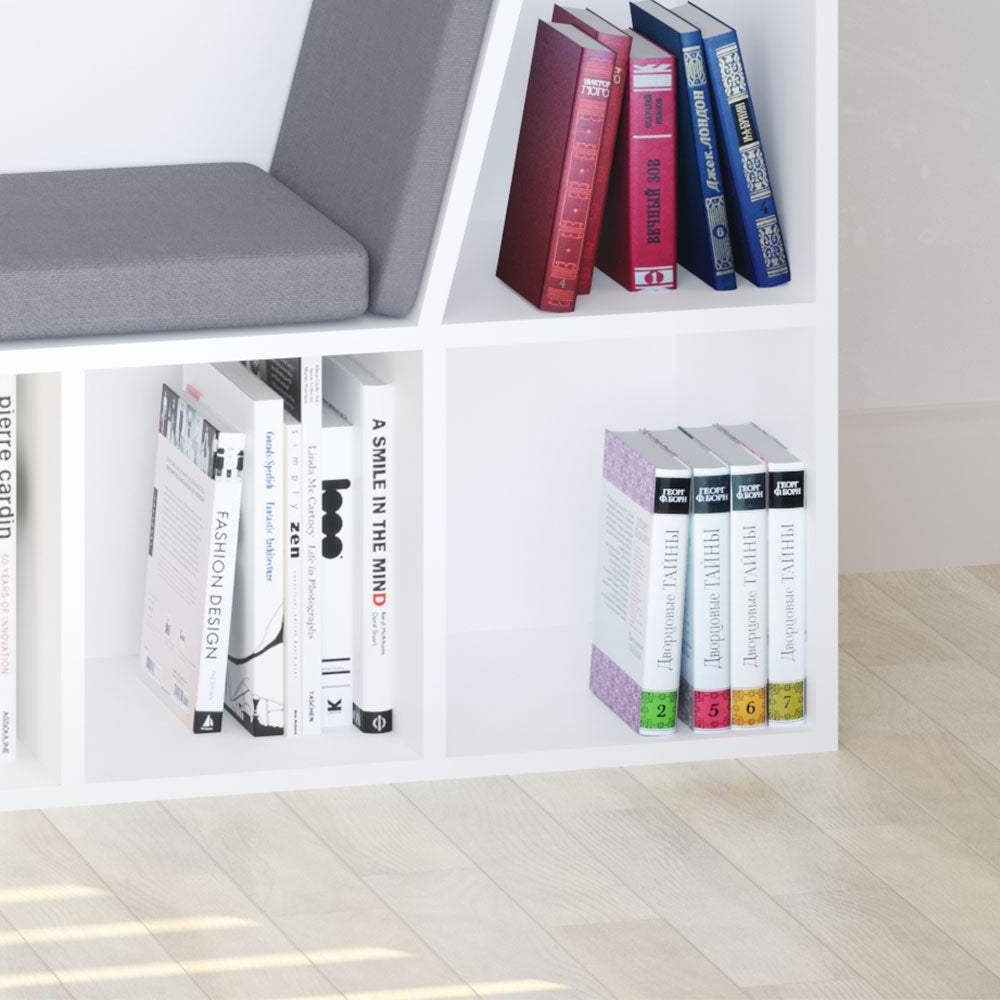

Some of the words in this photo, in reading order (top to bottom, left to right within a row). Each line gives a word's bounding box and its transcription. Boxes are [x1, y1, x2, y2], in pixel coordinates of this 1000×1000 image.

[693, 90, 712, 150] ЛОНДОН
[647, 159, 660, 183] ЗОВ
[704, 151, 720, 192] Джек
[644, 188, 660, 244] ВЕЧНЫЙ
[372, 418, 387, 430] A
[306, 445, 317, 475] Linda
[372, 436, 387, 489] SMILE
[662, 488, 686, 496] ГЕОРГ
[699, 486, 726, 494] ГЕОРГ
[738, 484, 761, 492] ГЕОРГ
[776, 480, 799, 489] ГЕОРГ
[305, 497, 317, 536] Cartney
[372, 496, 387, 514] IN
[212, 511, 229, 588] FASHION
[290, 521, 300, 558] zen
[306, 545, 317, 564] Life
[372, 519, 387, 552] THE
[777, 523, 795, 584] ТАЙНЫ
[306, 566, 317, 576] in
[660, 528, 680, 591] ТАЙНЫ
[701, 528, 720, 590] ТАЙНЫ
[740, 525, 757, 587] ТАЙНЫ
[0, 568, 9, 598] YEARS
[372, 557, 387, 607] MIND
[0, 601, 9, 613] OF
[305, 578, 317, 640] Photographs
[781, 587, 798, 662] Дворцовые
[0, 616, 9, 675] INNOVATION
[206, 595, 223, 660] DESIGN
[656, 594, 677, 672] Дворцовые
[703, 593, 725, 670] Дворцовые
[743, 590, 760, 668] Дворцовые
[656, 704, 666, 718] 2
[709, 703, 719, 717] 5
[746, 701, 755, 715] 6
[782, 696, 791, 709] 7
[2, 711, 10, 755] ASSOULINE
